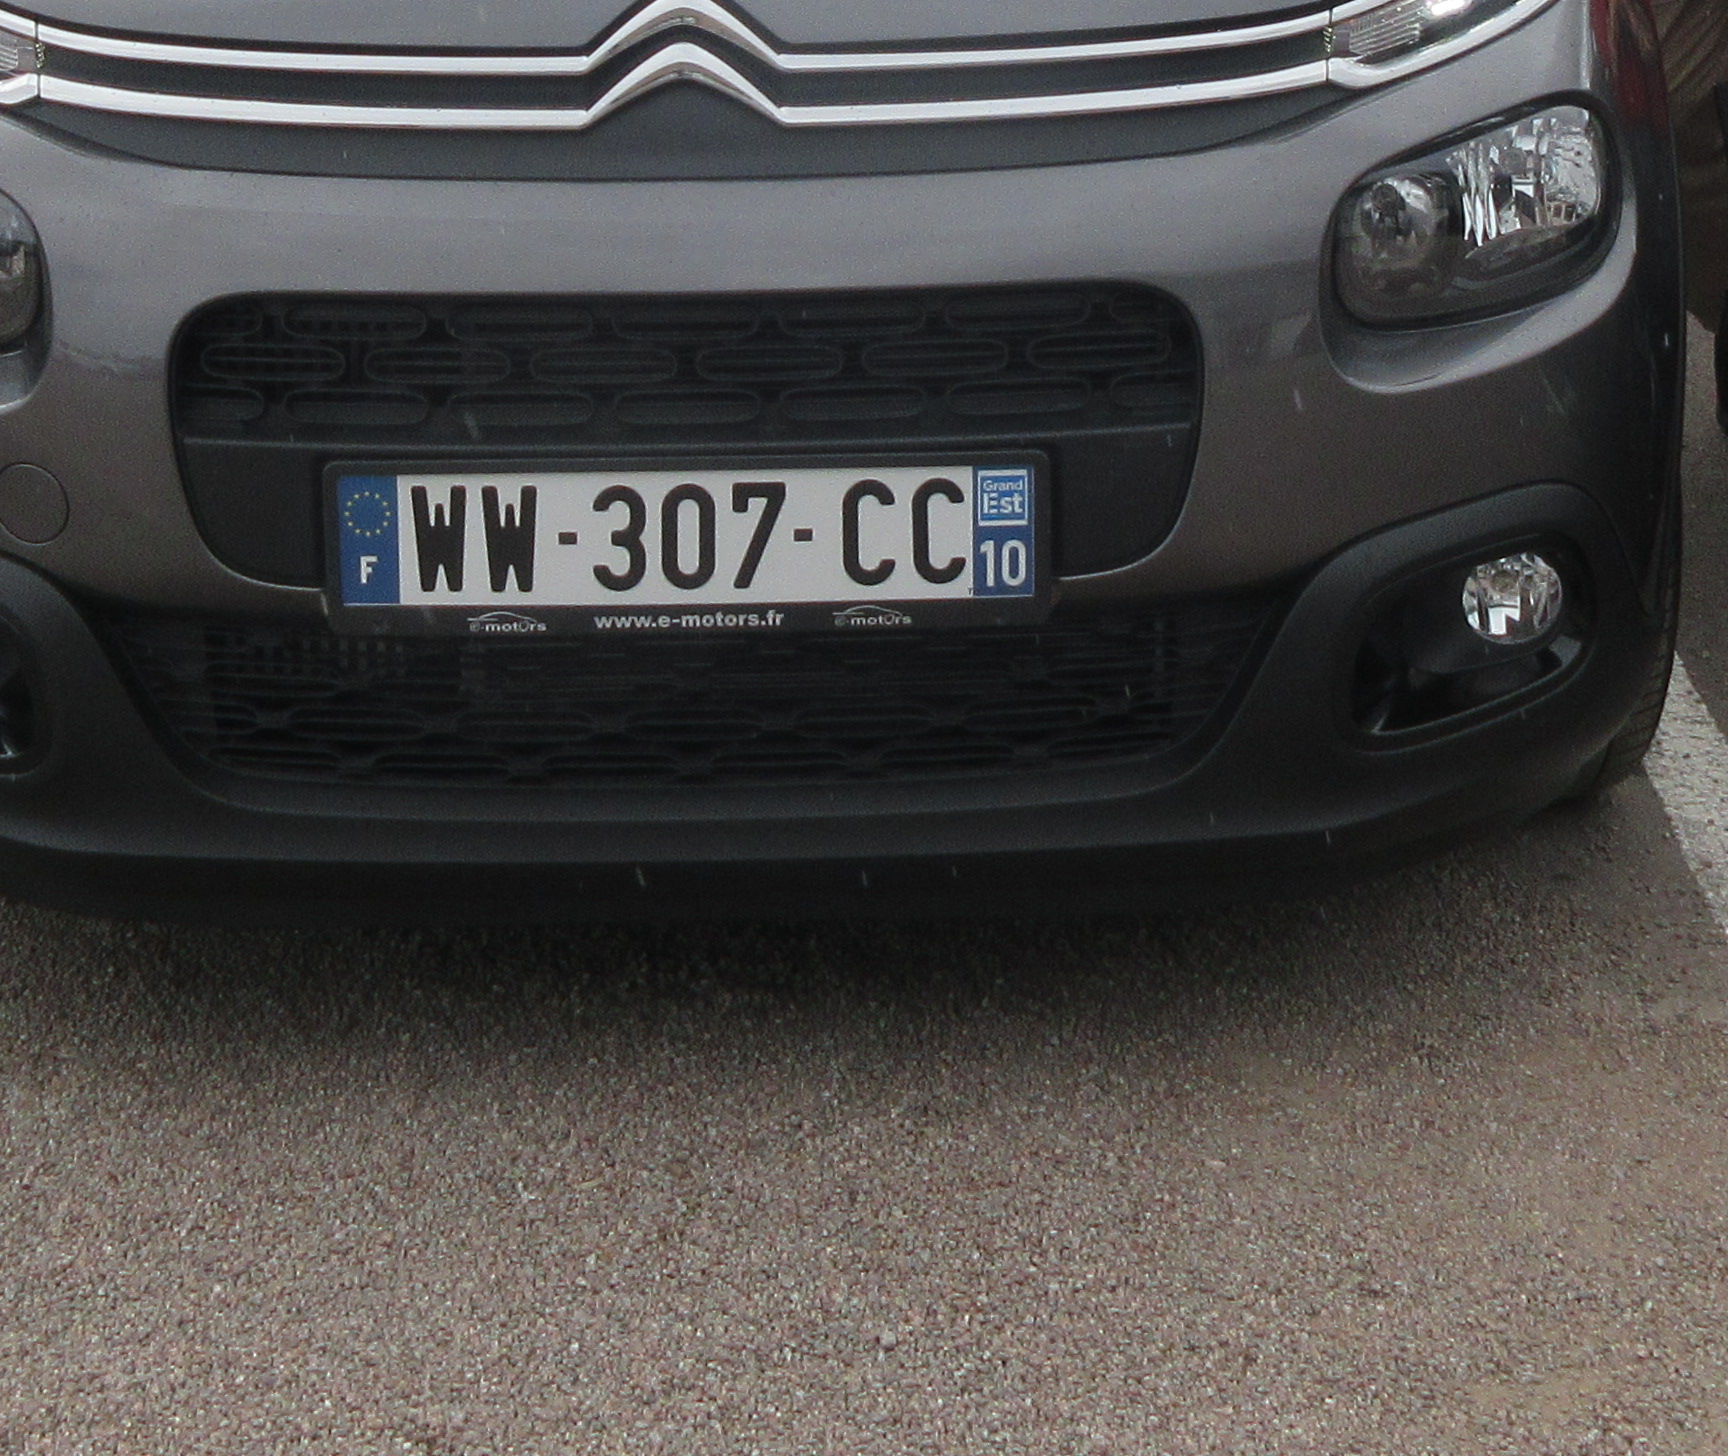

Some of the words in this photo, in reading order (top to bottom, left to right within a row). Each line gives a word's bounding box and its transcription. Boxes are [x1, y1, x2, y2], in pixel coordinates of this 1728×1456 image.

[983, 480, 1023, 491] Grand
[982, 493, 1024, 515] Est
[411, 477, 967, 593] WW-307-CC
[359, 555, 380, 585] F
[979, 539, 1027, 588] 10
[593, 609, 785, 629] www.e-motors.fr
